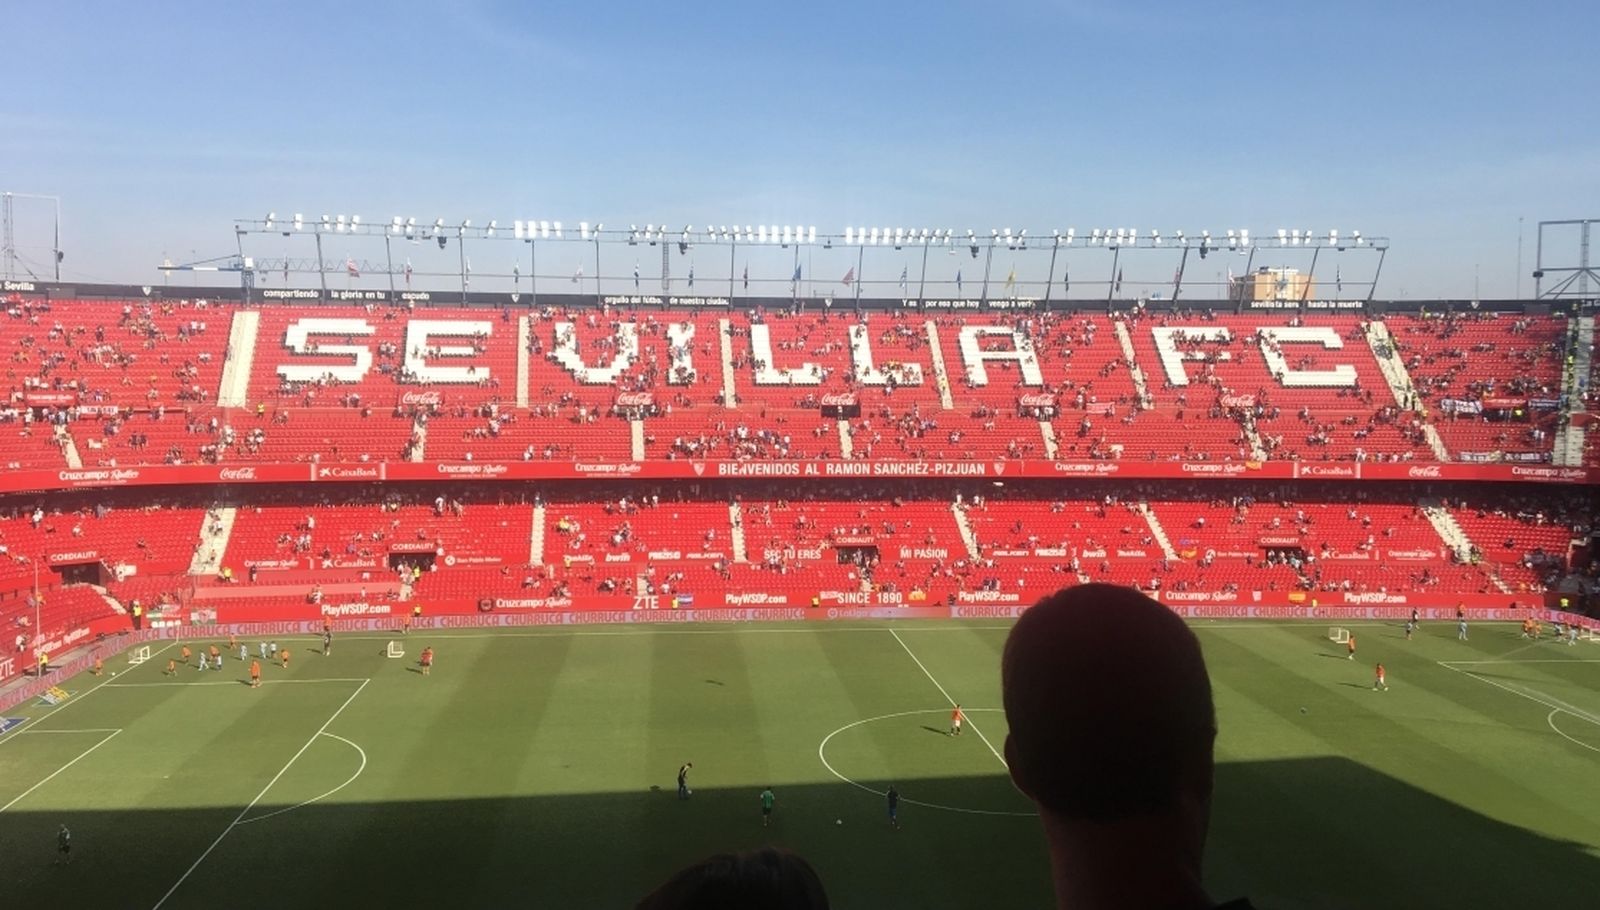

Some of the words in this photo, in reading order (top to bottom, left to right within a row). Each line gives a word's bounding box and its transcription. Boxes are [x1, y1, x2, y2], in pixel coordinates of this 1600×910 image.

[4, 280, 35, 291] Sevilla
[263, 288, 319, 298] compartiendo
[340, 290, 363, 299] gloria
[376, 291, 385, 300] tu
[925, 301, 937, 309] por
[952, 301, 965, 309] que
[277, 318, 1044, 386] SEVILLA
[1151, 327, 1359, 387] FC
[332, 467, 377, 477] CaixaBank
[438, 464, 482, 474] Cruzcampo
[575, 463, 616, 473] Cruzcampo
[719, 462, 800, 476] BIENVENIDOS
[805, 463, 820, 475] AL
[826, 462, 870, 475] RAMON
[874, 462, 985, 476] SANCHEZ-PIZJUAN
[1055, 462, 1095, 472] Cruzcampo
[1182, 462, 1222, 472] Cruzcampo
[1312, 466, 1353, 476] CaixaBank
[1512, 466, 1558, 477] Cruzcampo
[59, 470, 109, 482] Cruzcampo
[836, 536, 874, 544] CORDIALITY
[391, 543, 434, 551] CORDIALITY
[50, 551, 98, 562] CORDIALITY
[605, 552, 631, 562] bwin
[797, 549, 822, 559] ERES
[900, 549, 911, 559] MI
[1082, 549, 1107, 558] bwin
[1332, 551, 1370, 560] CaixaBank
[334, 558, 376, 568] CaixaBank
[725, 593, 787, 606] PlayWSOP.com
[837, 592, 871, 604] SINCE
[877, 592, 903, 604] 1890
[958, 590, 1020, 603] PlayWSOP.com
[1165, 591, 1210, 601] Cruzcampo
[1344, 592, 1407, 605] PlayWSOP.com
[496, 598, 543, 609] Cruzcampo
[633, 596, 660, 610] ZTE
[321, 602, 391, 616] PlayWSOP.com
[958, 607, 1011, 617] CHURRUCA
[1194, 606, 1248, 617] CHURRUCA
[1253, 607, 1307, 617] CHURRUCA
[1313, 607, 1367, 617] CHURRUCA
[1433, 607, 1487, 618] CHURUCA
[504, 613, 564, 626] CHURRUCA
[569, 612, 625, 624] CHURRUCA
[632, 611, 686, 622] CHURRUCA
[693, 610, 749, 621] CHURRUCA
[438, 615, 498, 628] CHURRUCA
[166, 624, 231, 639] CHURRUCA
[237, 621, 301, 636] CHURRUCA
